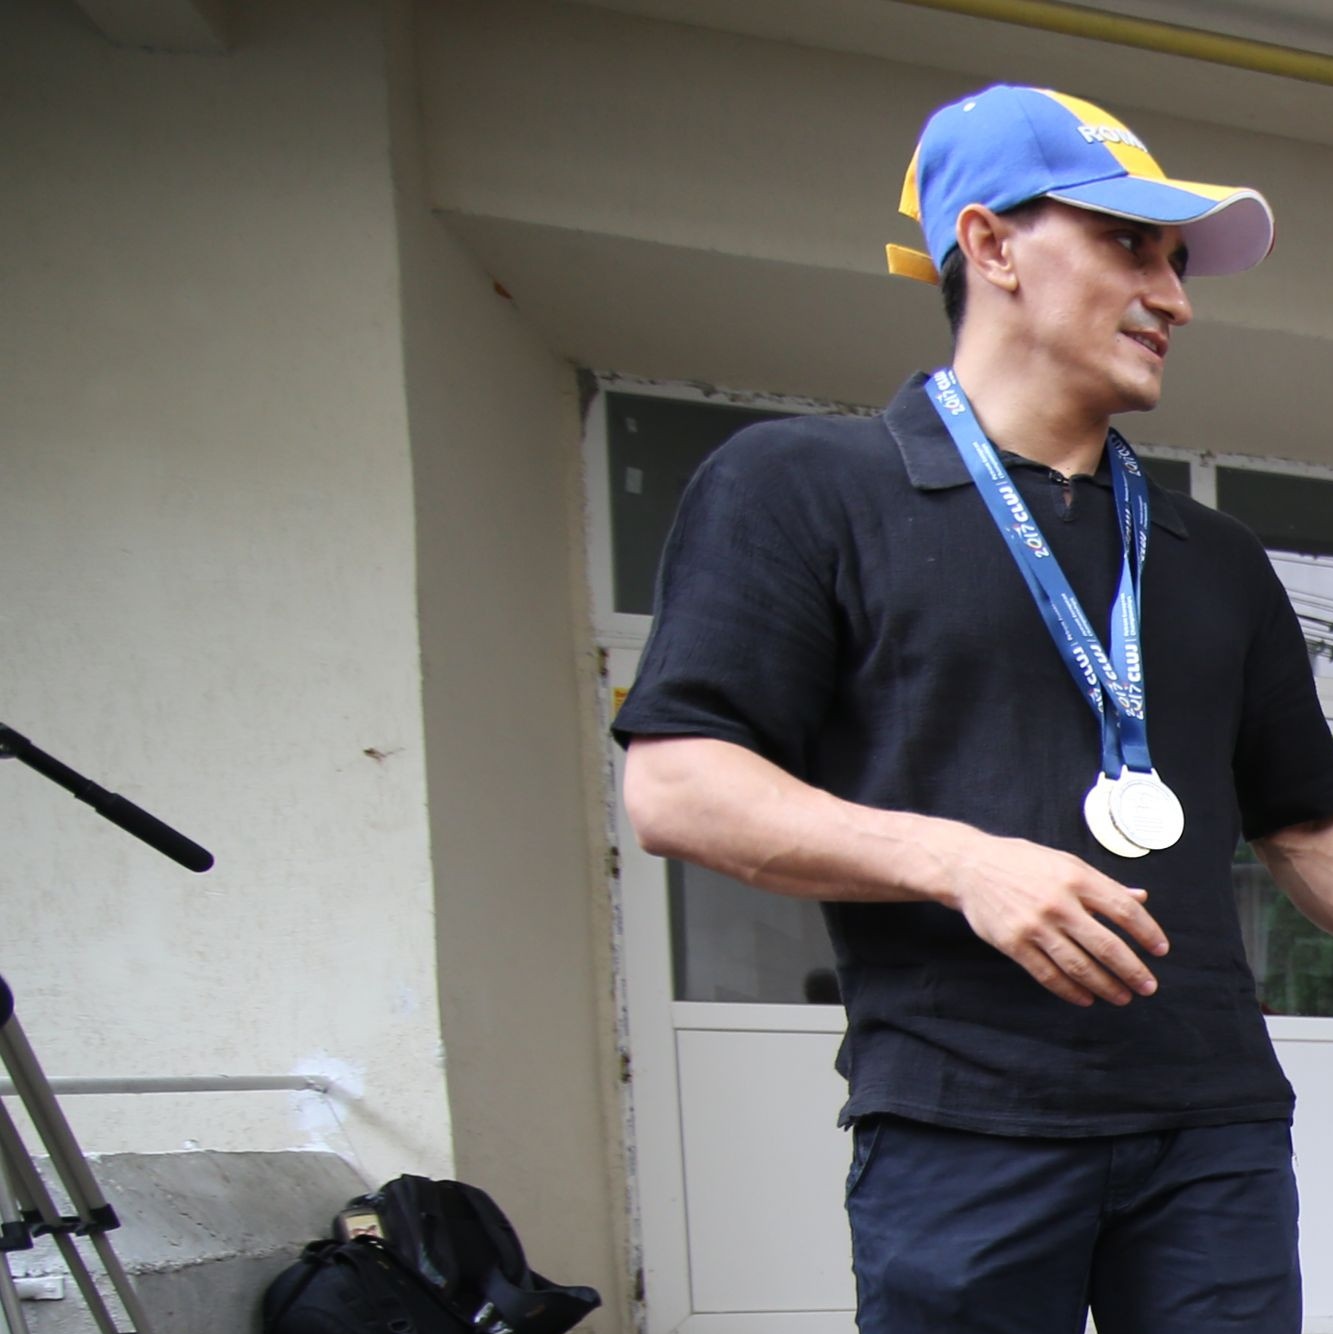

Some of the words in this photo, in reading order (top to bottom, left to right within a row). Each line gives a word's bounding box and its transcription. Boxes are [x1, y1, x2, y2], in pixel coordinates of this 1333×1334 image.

[999, 486, 1029, 523] CLUJ
[1020, 522, 1049, 558] 2017
[1072, 646, 1097, 685] CLUJ
[1090, 644, 1118, 681] CLUJ
[1125, 644, 1141, 682] CLUJ
